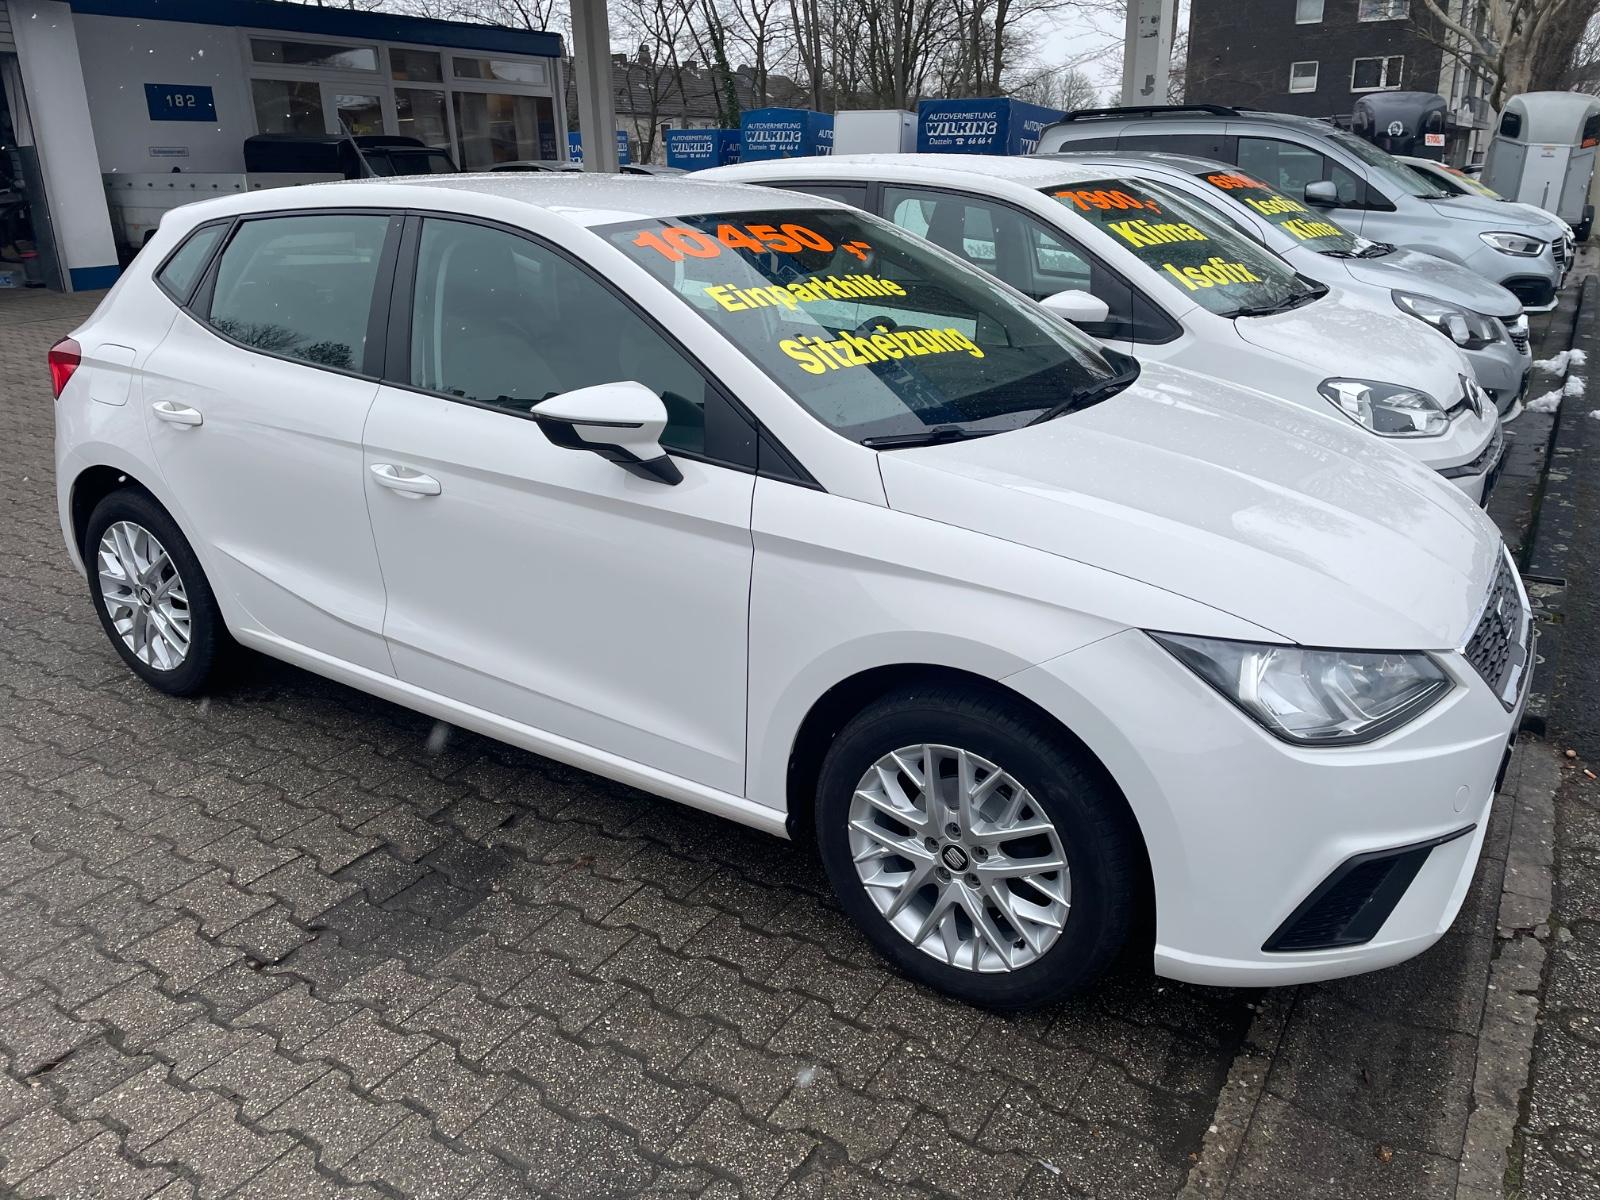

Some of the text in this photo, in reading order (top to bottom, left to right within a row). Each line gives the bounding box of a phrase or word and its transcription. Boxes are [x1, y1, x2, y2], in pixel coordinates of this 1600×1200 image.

[166, 94, 196, 107] 182
[928, 112, 997, 120] AUTOVERMIETUNG
[747, 122, 801, 130] AUTOVERMIETUNG
[925, 121, 997, 135] WILKING
[745, 131, 802, 142] WILKING
[671, 143, 713, 152] WILKING
[1108, 219, 1209, 248] Klima
[1280, 218, 1343, 240] Klima
[1162, 257, 1263, 291] Isofix
[704, 274, 907, 313] Einparkhilfe
[779, 325, 985, 375] Sitzheizung
